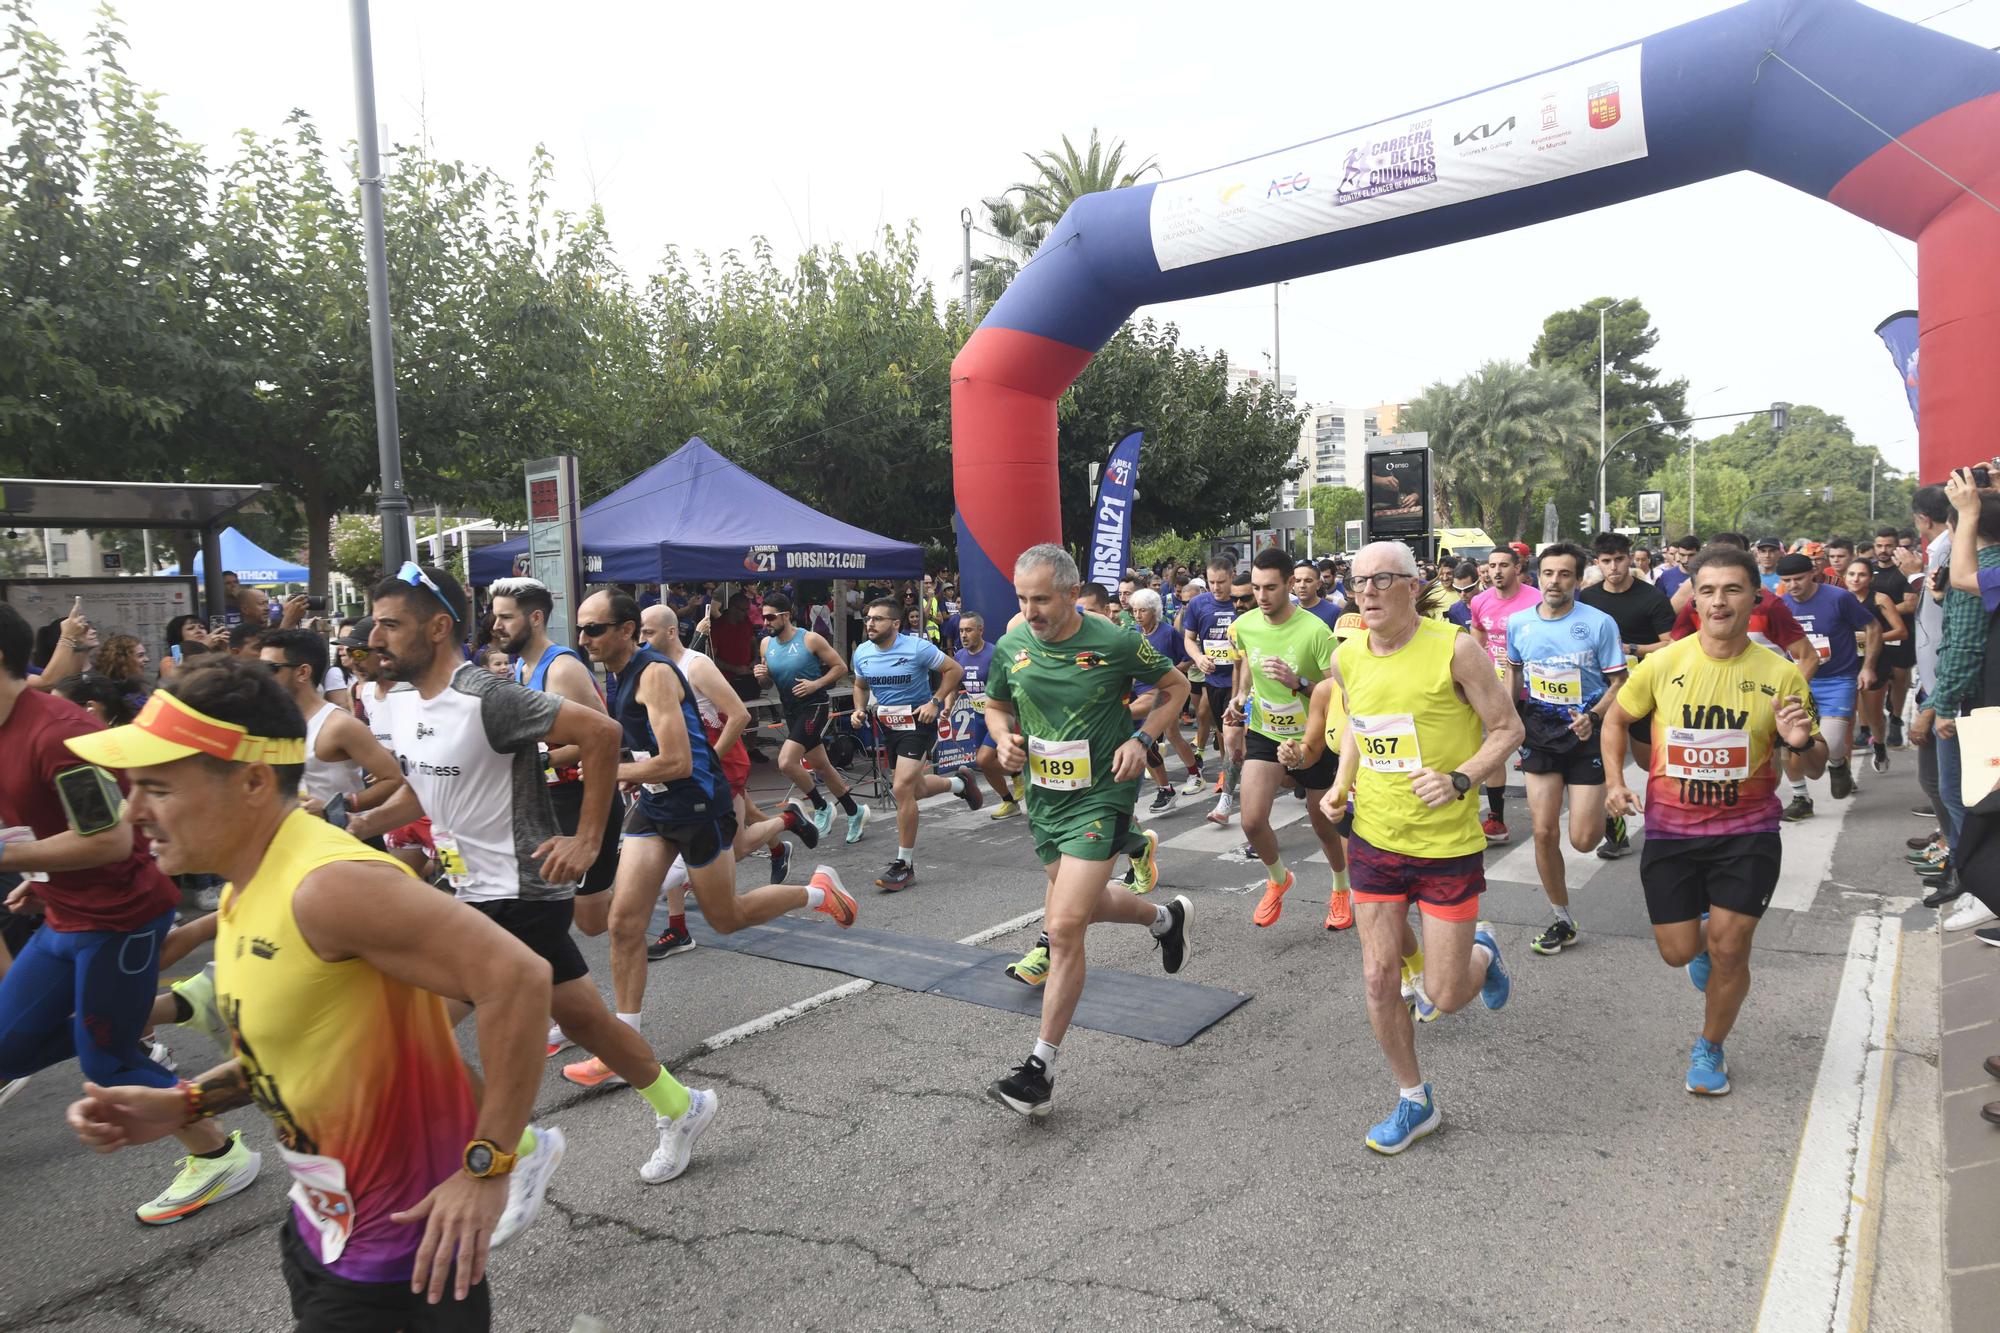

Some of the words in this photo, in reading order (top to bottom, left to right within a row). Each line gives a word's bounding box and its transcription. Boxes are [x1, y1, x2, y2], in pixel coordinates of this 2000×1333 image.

[1409, 119, 1433, 133] 2022
[1453, 116, 1516, 146] KIA
[1371, 129, 1432, 157] CARRERA
[1546, 140, 1567, 150] Murcia
[1390, 149, 1407, 165] DE
[1409, 141, 1434, 161] LAS
[1369, 155, 1436, 186] CIUDADES
[1339, 192, 1361, 203] CONTRA
[1363, 189, 1370, 197] EL
[1394, 181, 1404, 189] DE
[1115, 467, 1129, 487] 21
[757, 552, 776, 572] 21
[786, 552, 866, 569] DORSAL21.COM
[1210, 649, 1228, 658] 225
[1540, 680, 1568, 694] 166
[1269, 714, 1296, 725] 222
[1364, 738, 1398, 755] 367
[1683, 748, 1730, 765] 008
[1040, 759, 1074, 775] 189
